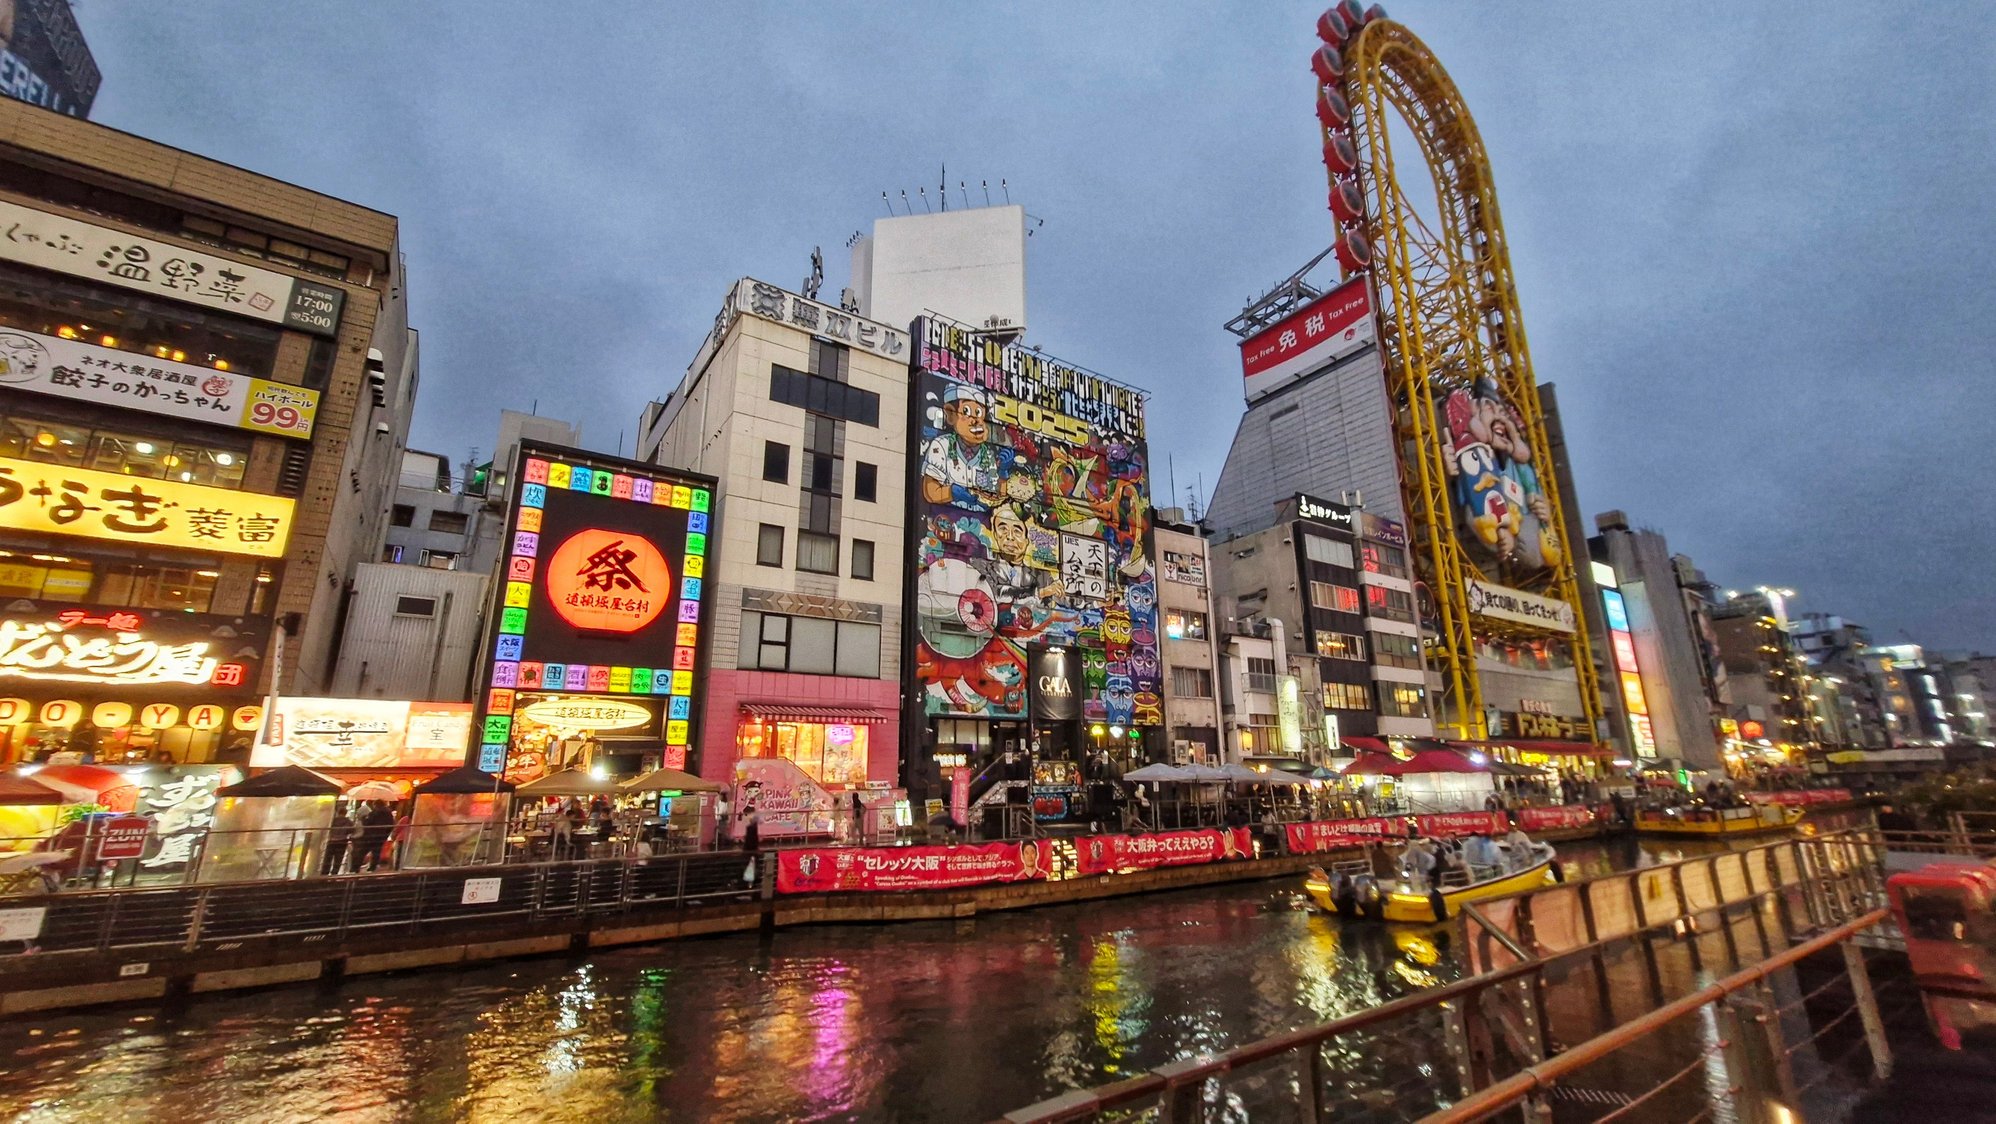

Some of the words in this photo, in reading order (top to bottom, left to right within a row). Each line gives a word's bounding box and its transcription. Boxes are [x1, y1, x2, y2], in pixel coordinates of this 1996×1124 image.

[96, 244, 247, 304] 温野菜
[295, 295, 334, 313] 17:00
[1278, 312, 1326, 353] 免税
[81, 354, 198, 387] ネオ大衆居酒屋
[51, 364, 232, 412] 餃子のかっちゃん
[255, 391, 313, 408] ハイボール
[994, 396, 1090, 446] 2025
[576, 540, 651, 594] 祭
[565, 592, 650, 613] 道頓堀屋台村
[760, 799, 799, 811] KAWAII
[765, 788, 792, 800] PINK
